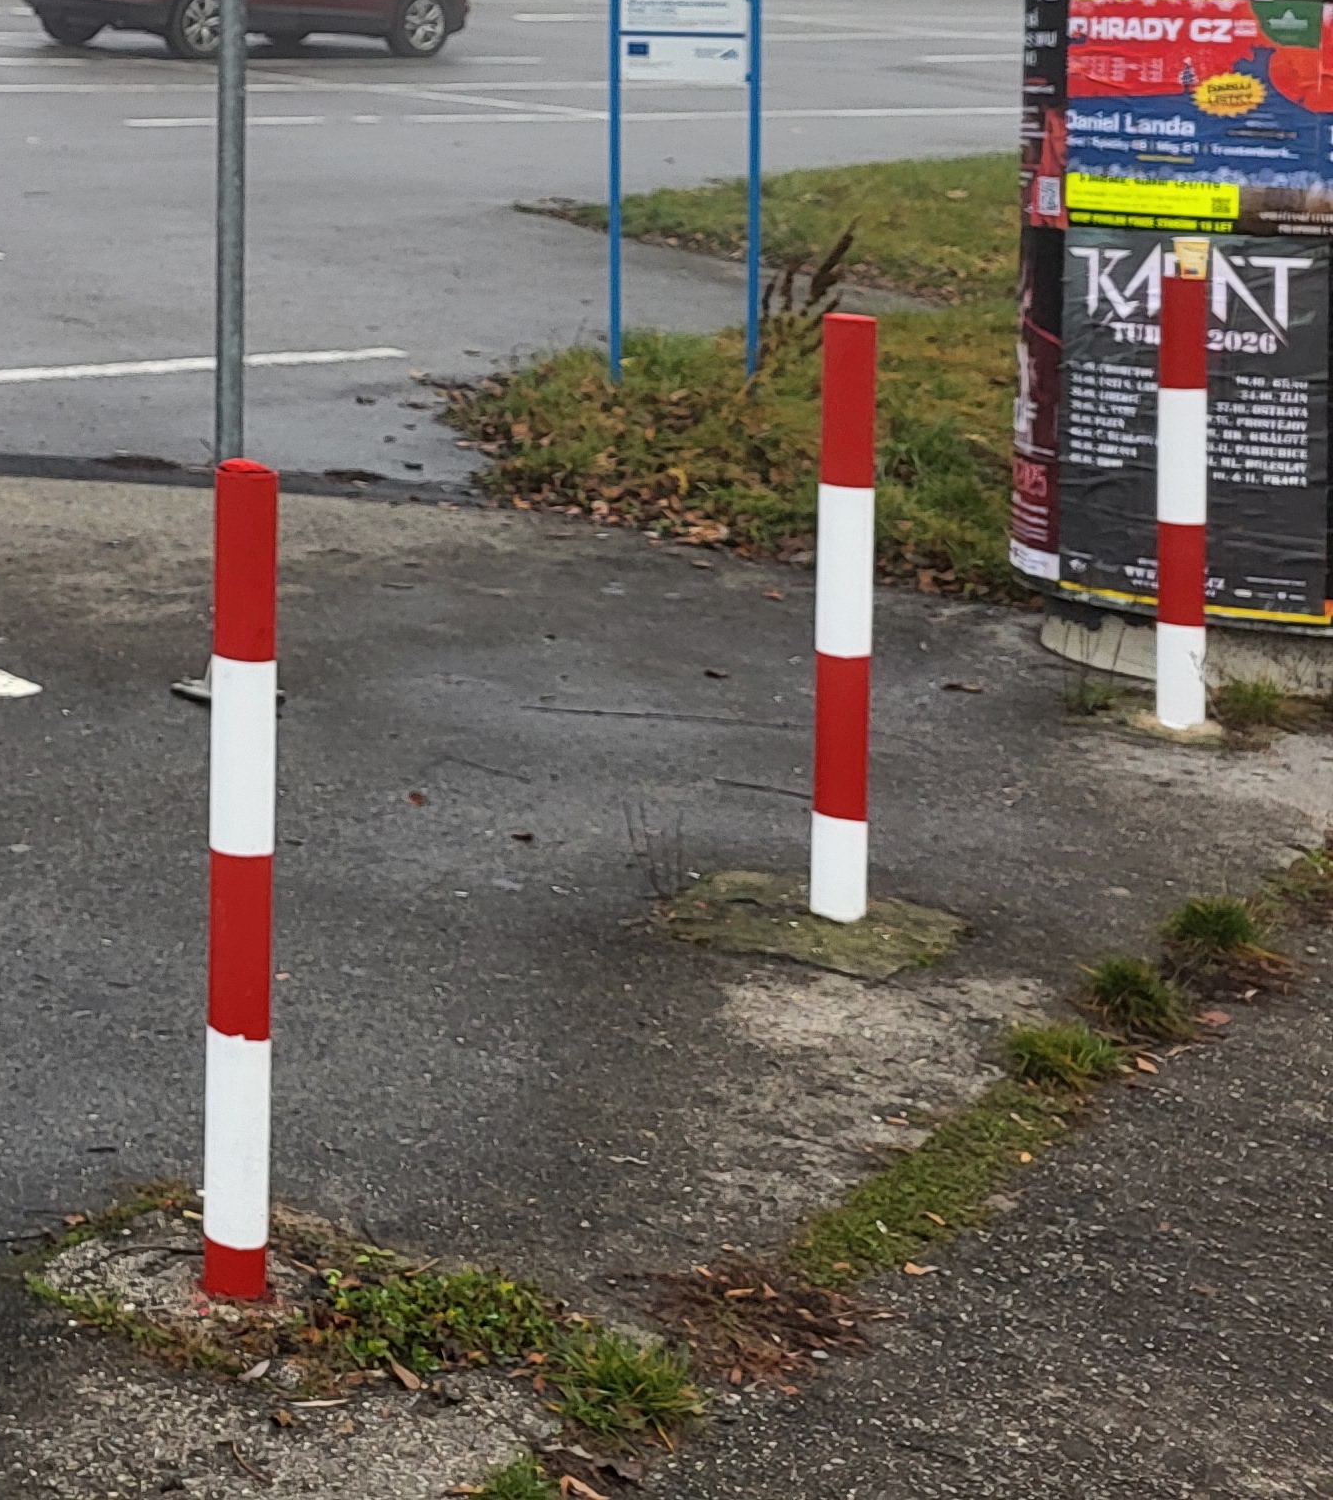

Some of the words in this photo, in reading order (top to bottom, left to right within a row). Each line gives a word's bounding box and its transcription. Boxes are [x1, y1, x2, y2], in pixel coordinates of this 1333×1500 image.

[1090, 17, 1183, 42] HRADY
[1189, 18, 1233, 43] CZ
[1065, 109, 1120, 134] Daniel
[1124, 112, 1196, 137] Landa
[1206, 329, 1278, 354] 2026
[1279, 391, 1309, 404] ZLÍN
[1252, 404, 1309, 418] OSTRAVA
[1249, 430, 1309, 446] KRÁLOVÉ
[1235, 444, 1308, 460] PARDUBICE
[1262, 474, 1308, 488] PRAHA
